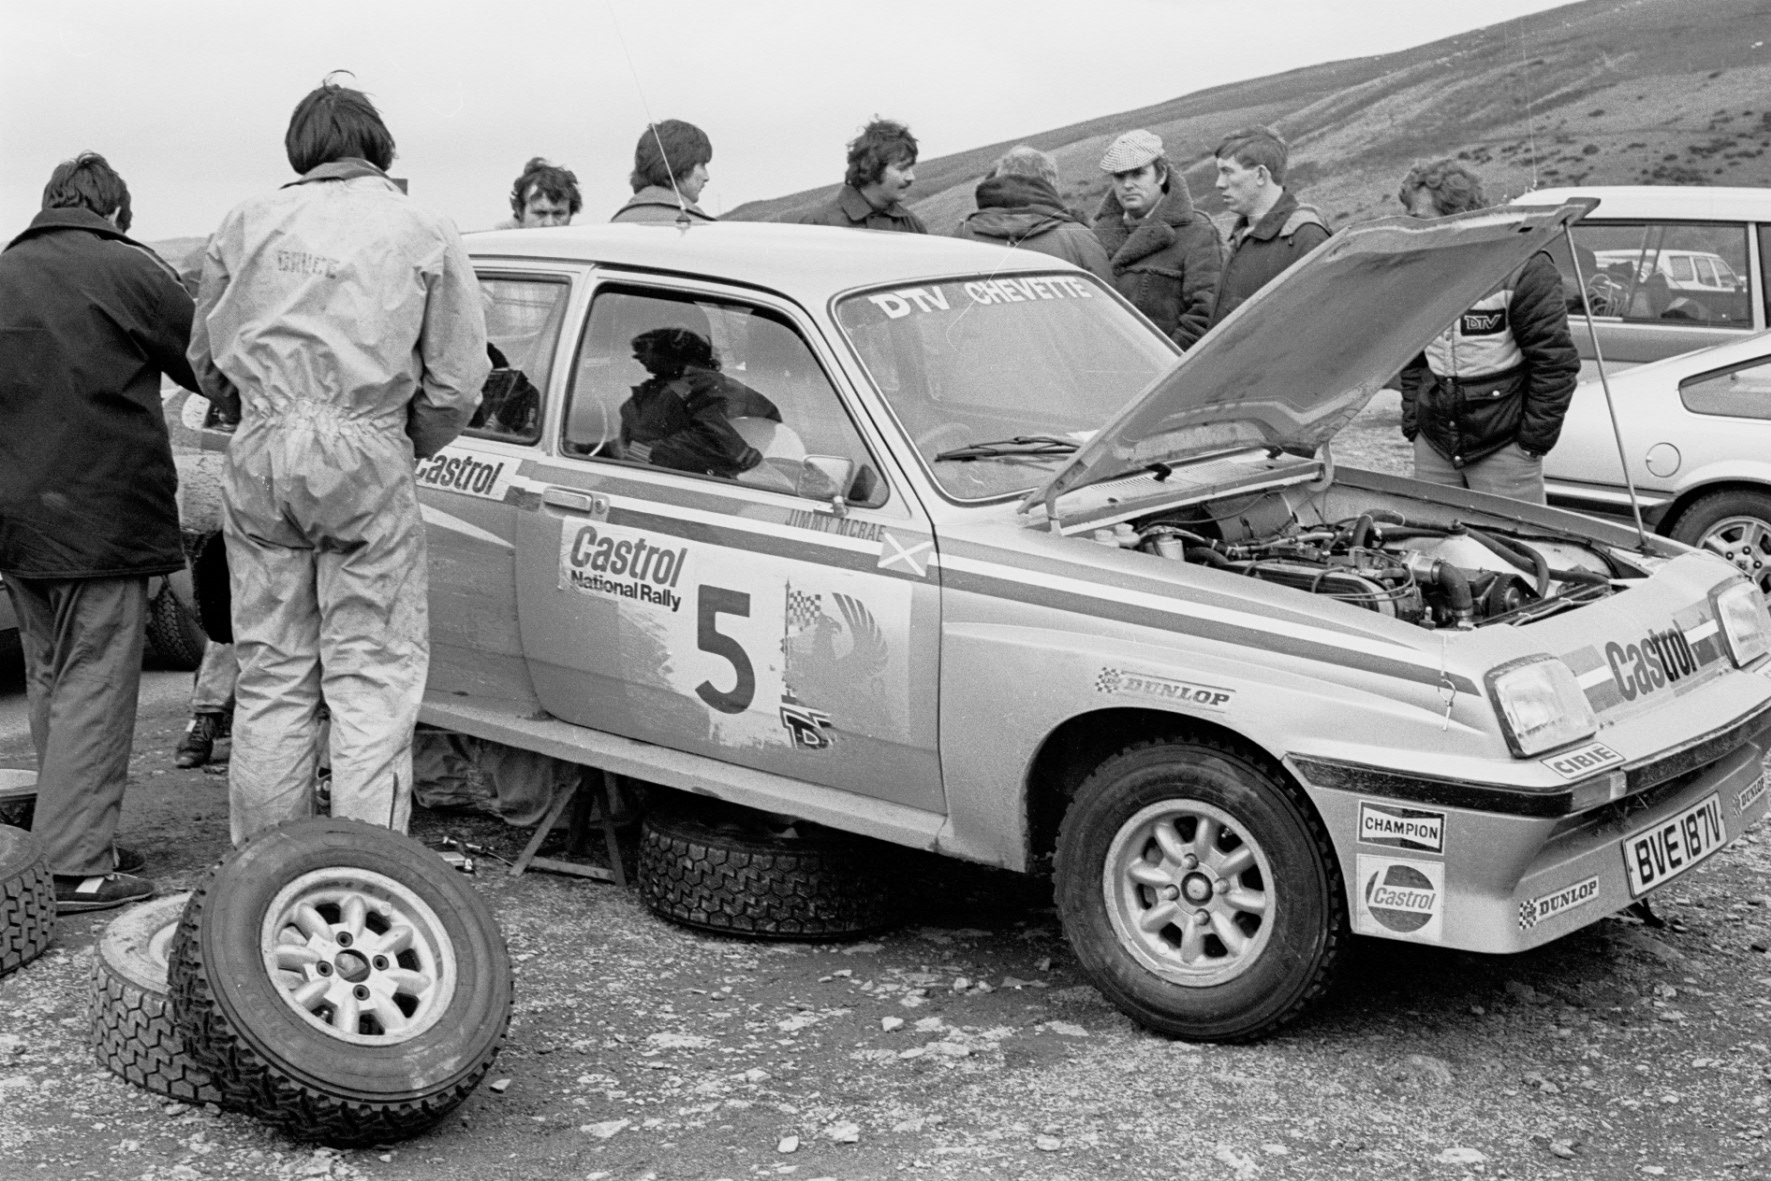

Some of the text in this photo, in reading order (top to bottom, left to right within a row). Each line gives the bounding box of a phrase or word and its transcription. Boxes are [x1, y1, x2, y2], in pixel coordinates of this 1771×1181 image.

[868, 277, 1093, 319] DTV CHEVETTE
[1464, 314, 1502, 330] DTV
[785, 508, 887, 543] JIMMY MCRAE
[570, 525, 688, 588] Castrol
[571, 569, 682, 612] National Rally
[695, 583, 756, 715] 5
[1605, 618, 1698, 701] Castrol
[1123, 677, 1230, 706] DUNLOP
[1365, 817, 1438, 839] CHAMPION
[1635, 799, 1721, 885] BVE 187V
[1373, 887, 1436, 910] Castrol
[1539, 881, 1597, 916] DUNLOP
